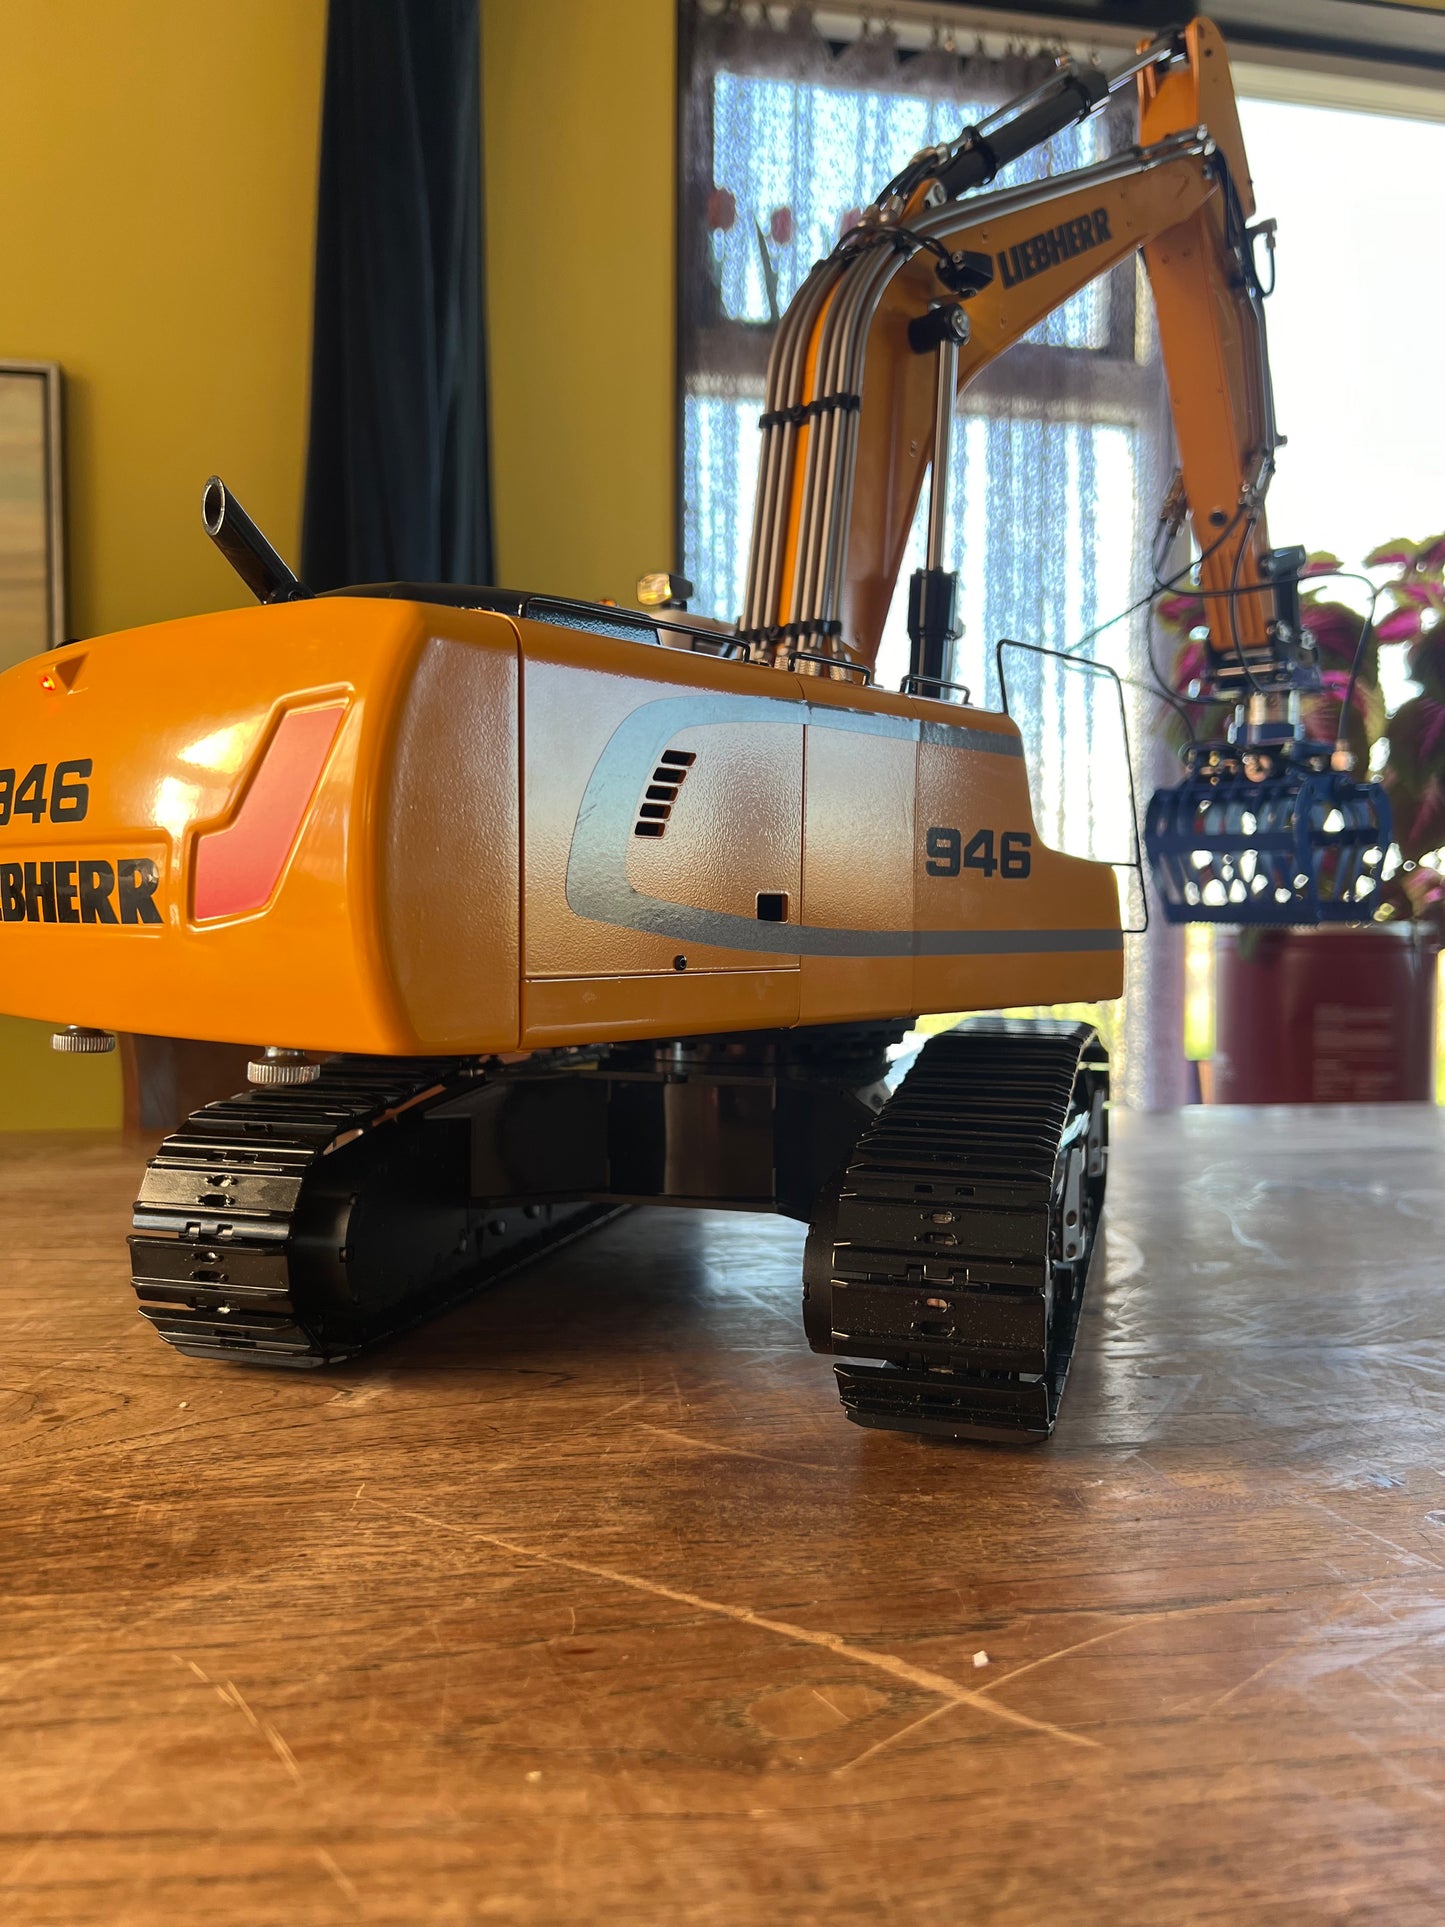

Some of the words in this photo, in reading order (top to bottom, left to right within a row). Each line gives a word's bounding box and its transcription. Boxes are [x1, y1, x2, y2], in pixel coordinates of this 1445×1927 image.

[997, 208, 1112, 289] LIEBHERR
[925, 827, 1032, 879] 946
[0, 858, 164, 924] BHERR
